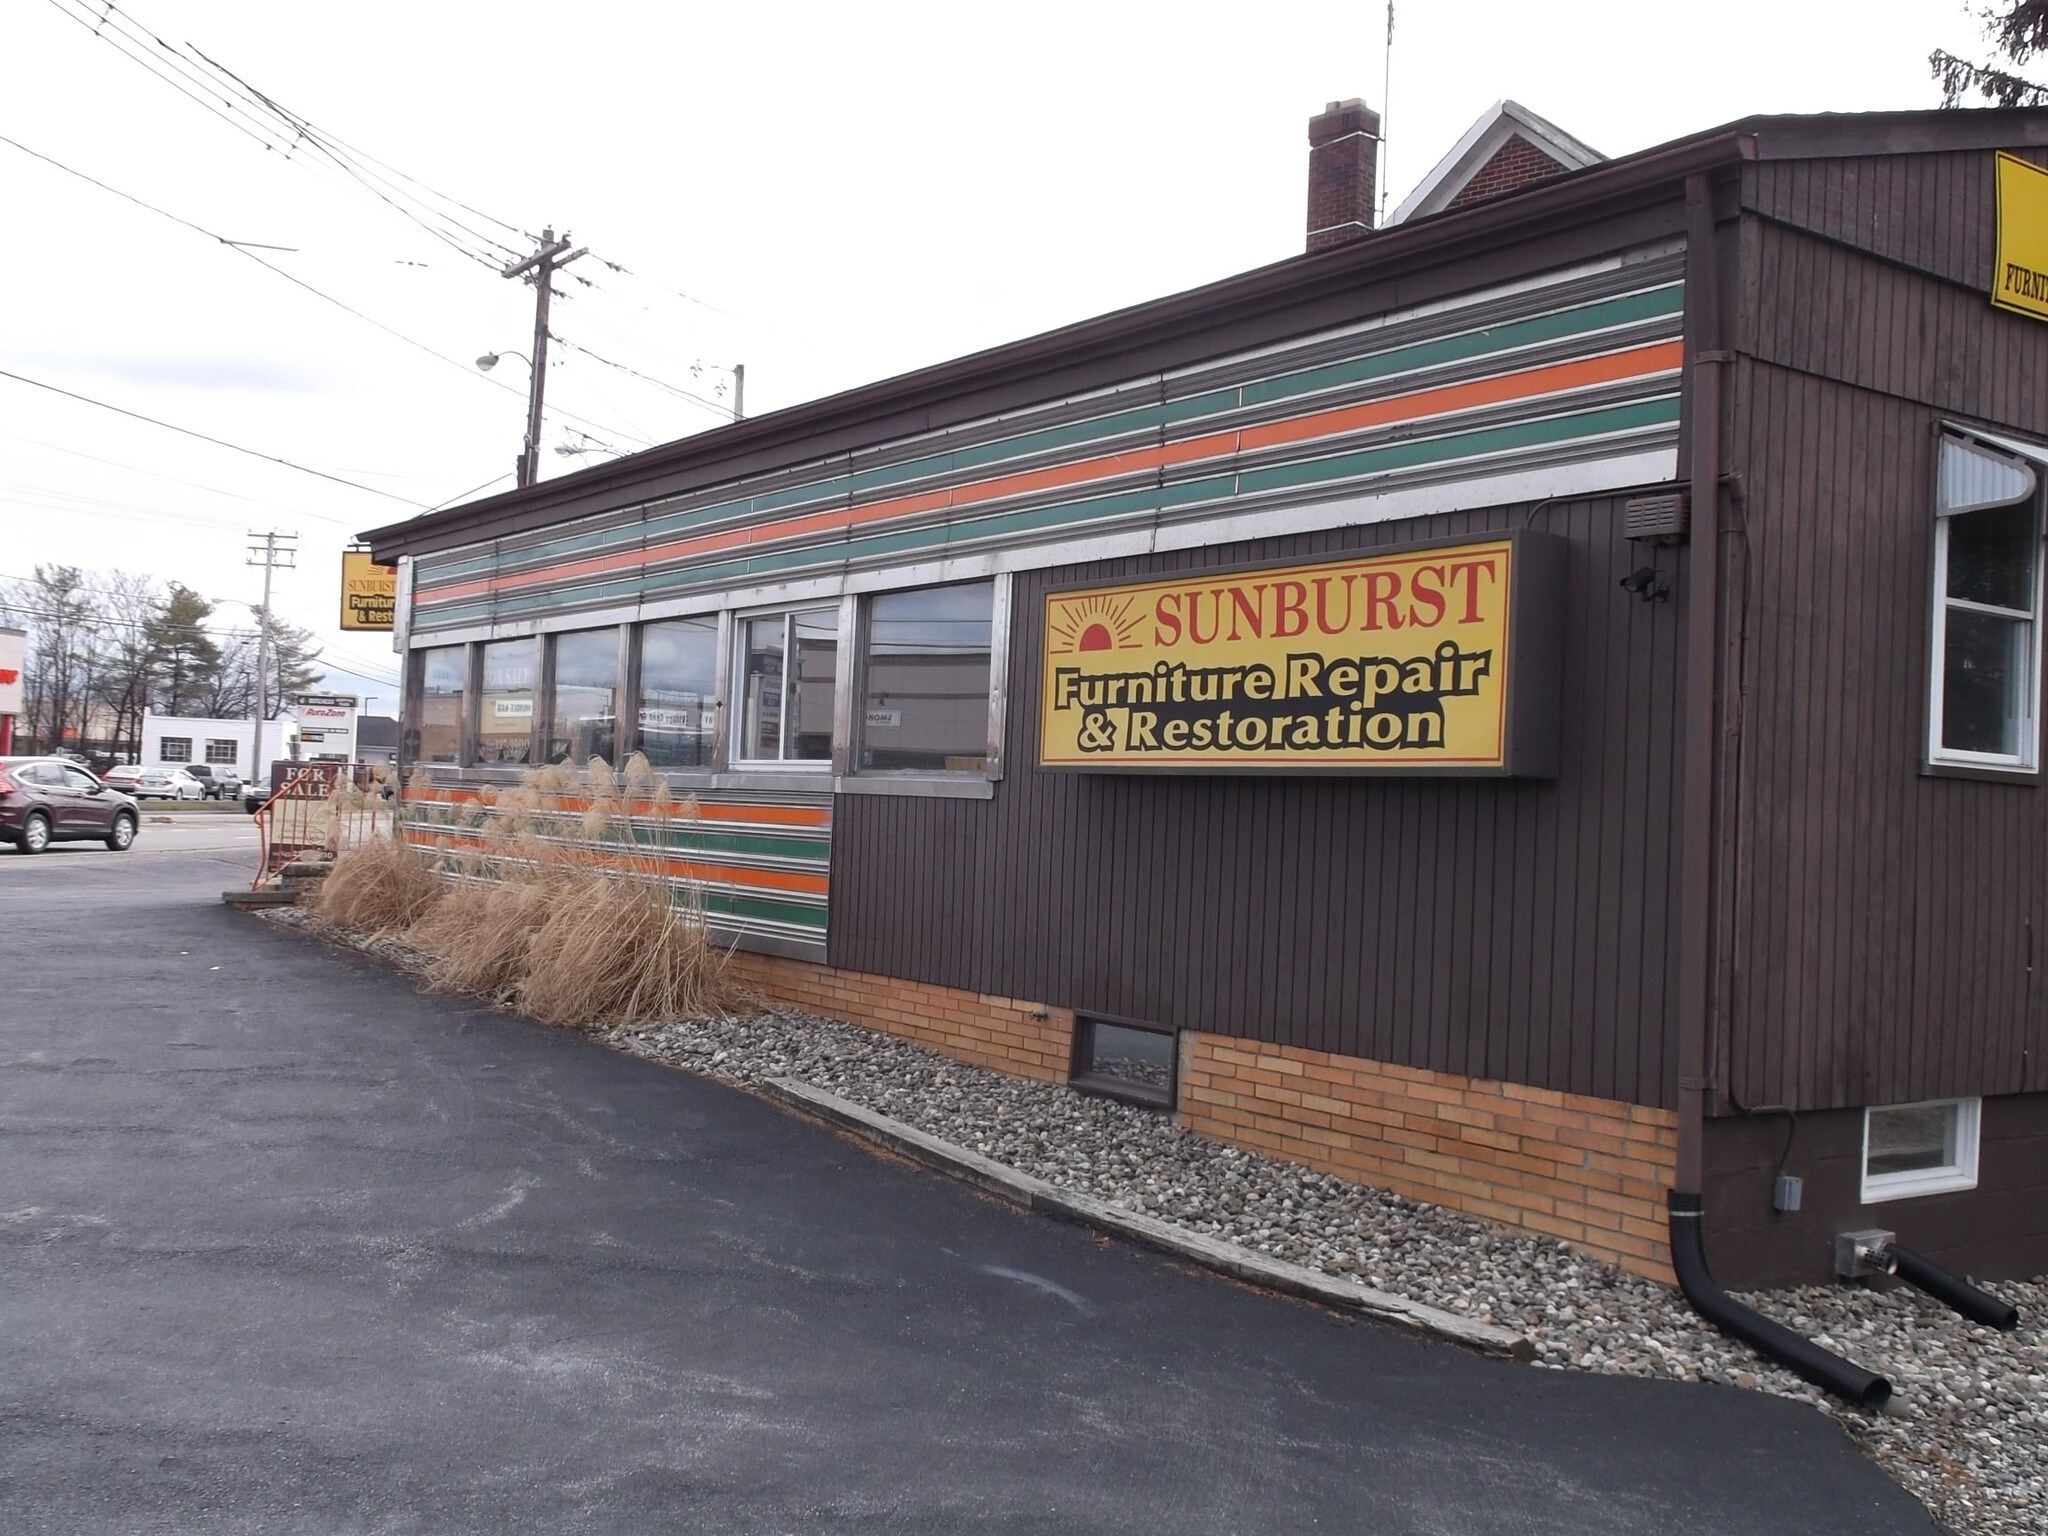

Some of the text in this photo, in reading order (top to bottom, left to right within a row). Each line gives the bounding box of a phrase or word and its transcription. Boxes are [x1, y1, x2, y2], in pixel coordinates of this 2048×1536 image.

[348, 580, 396, 592] SUNBURST
[351, 594, 395, 609] Furnitur
[1153, 560, 1496, 647] SUNBURST
[358, 609, 394, 623] & Rest
[1056, 642, 1491, 709] Furniture Repair
[306, 708, 346, 717] AutoZone
[1078, 702, 1445, 750] & Restoration
[286, 767, 327, 782] FOR
[281, 781, 330, 797] SALE
